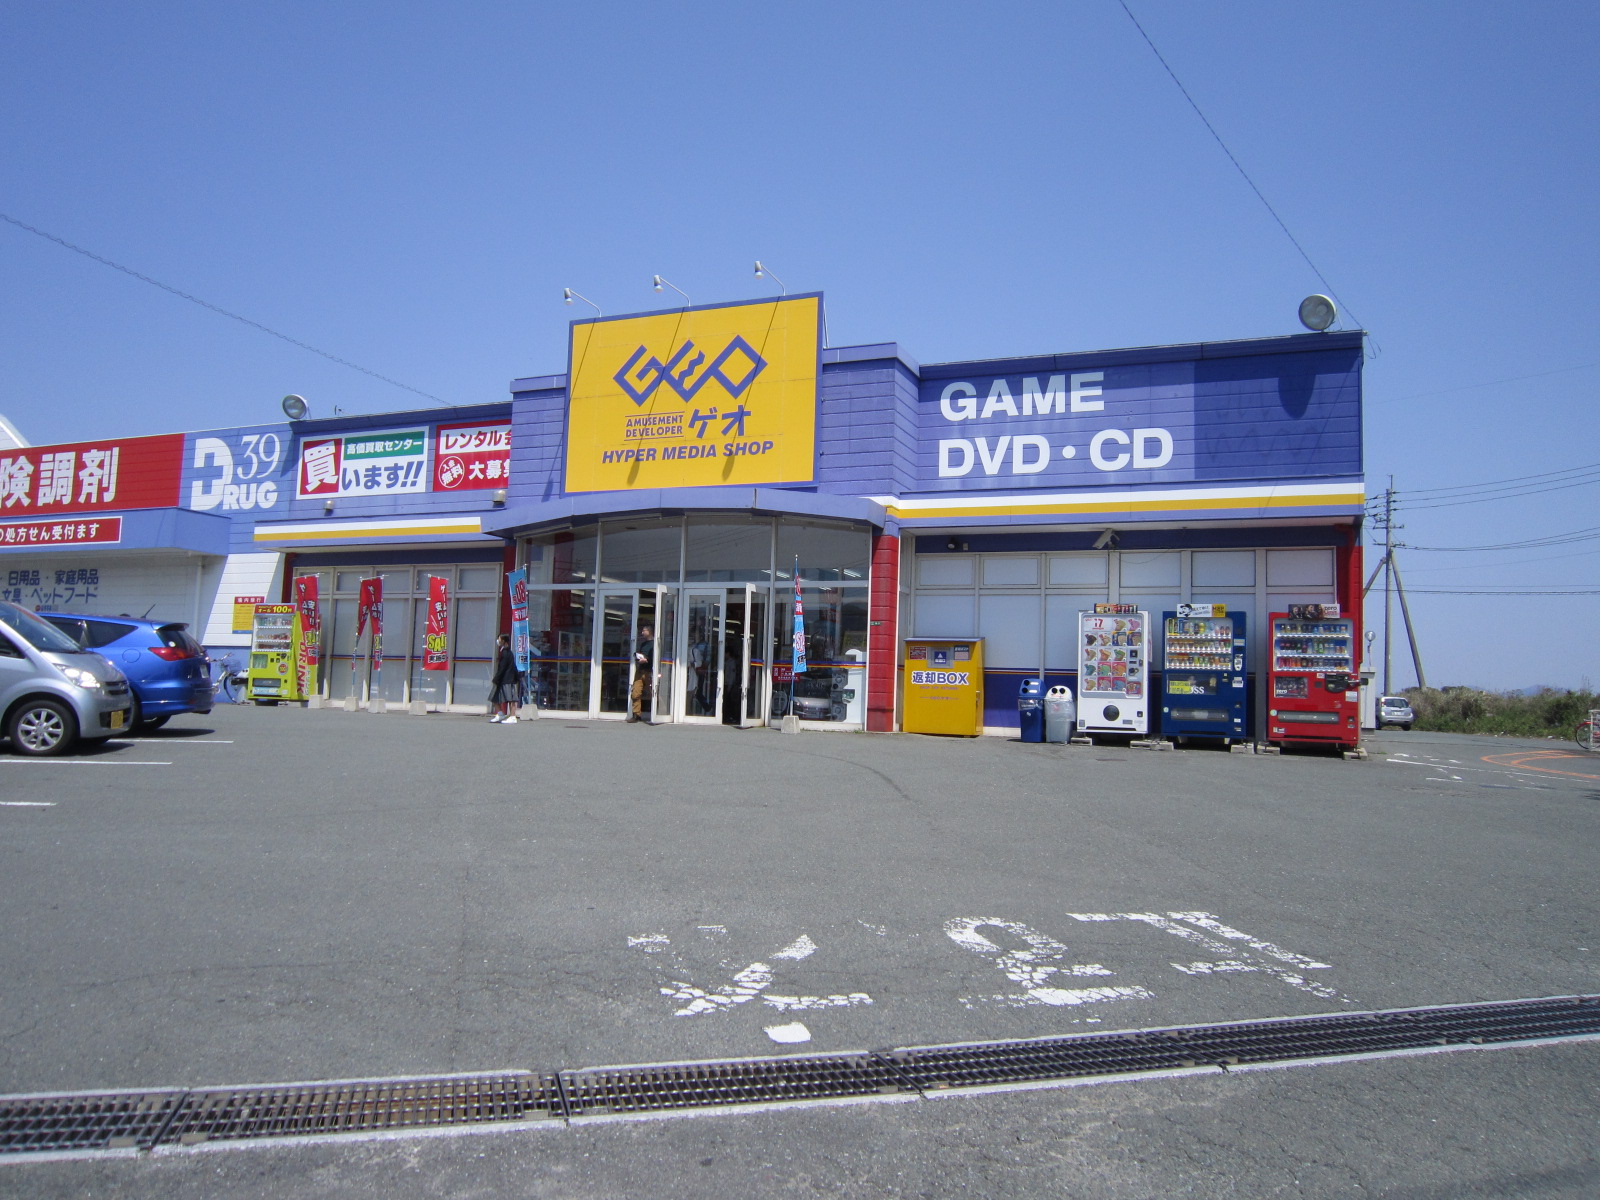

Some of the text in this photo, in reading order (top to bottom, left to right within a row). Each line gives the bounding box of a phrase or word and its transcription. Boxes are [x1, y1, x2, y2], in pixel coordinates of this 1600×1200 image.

[613, 335, 768, 407] GEO
[940, 371, 1105, 422] GAME
[625, 414, 684, 428] AMUSEMENT
[625, 425, 683, 438] DEVELOPER
[688, 404, 752, 439] ゲオ
[237, 433, 281, 480] 39
[347, 438, 423, 455] 高価買取センター
[602, 440, 774, 464] HYPER MEDIA SHOP
[190, 437, 279, 511] DRUG
[912, 671, 969, 686] 返却BOX
